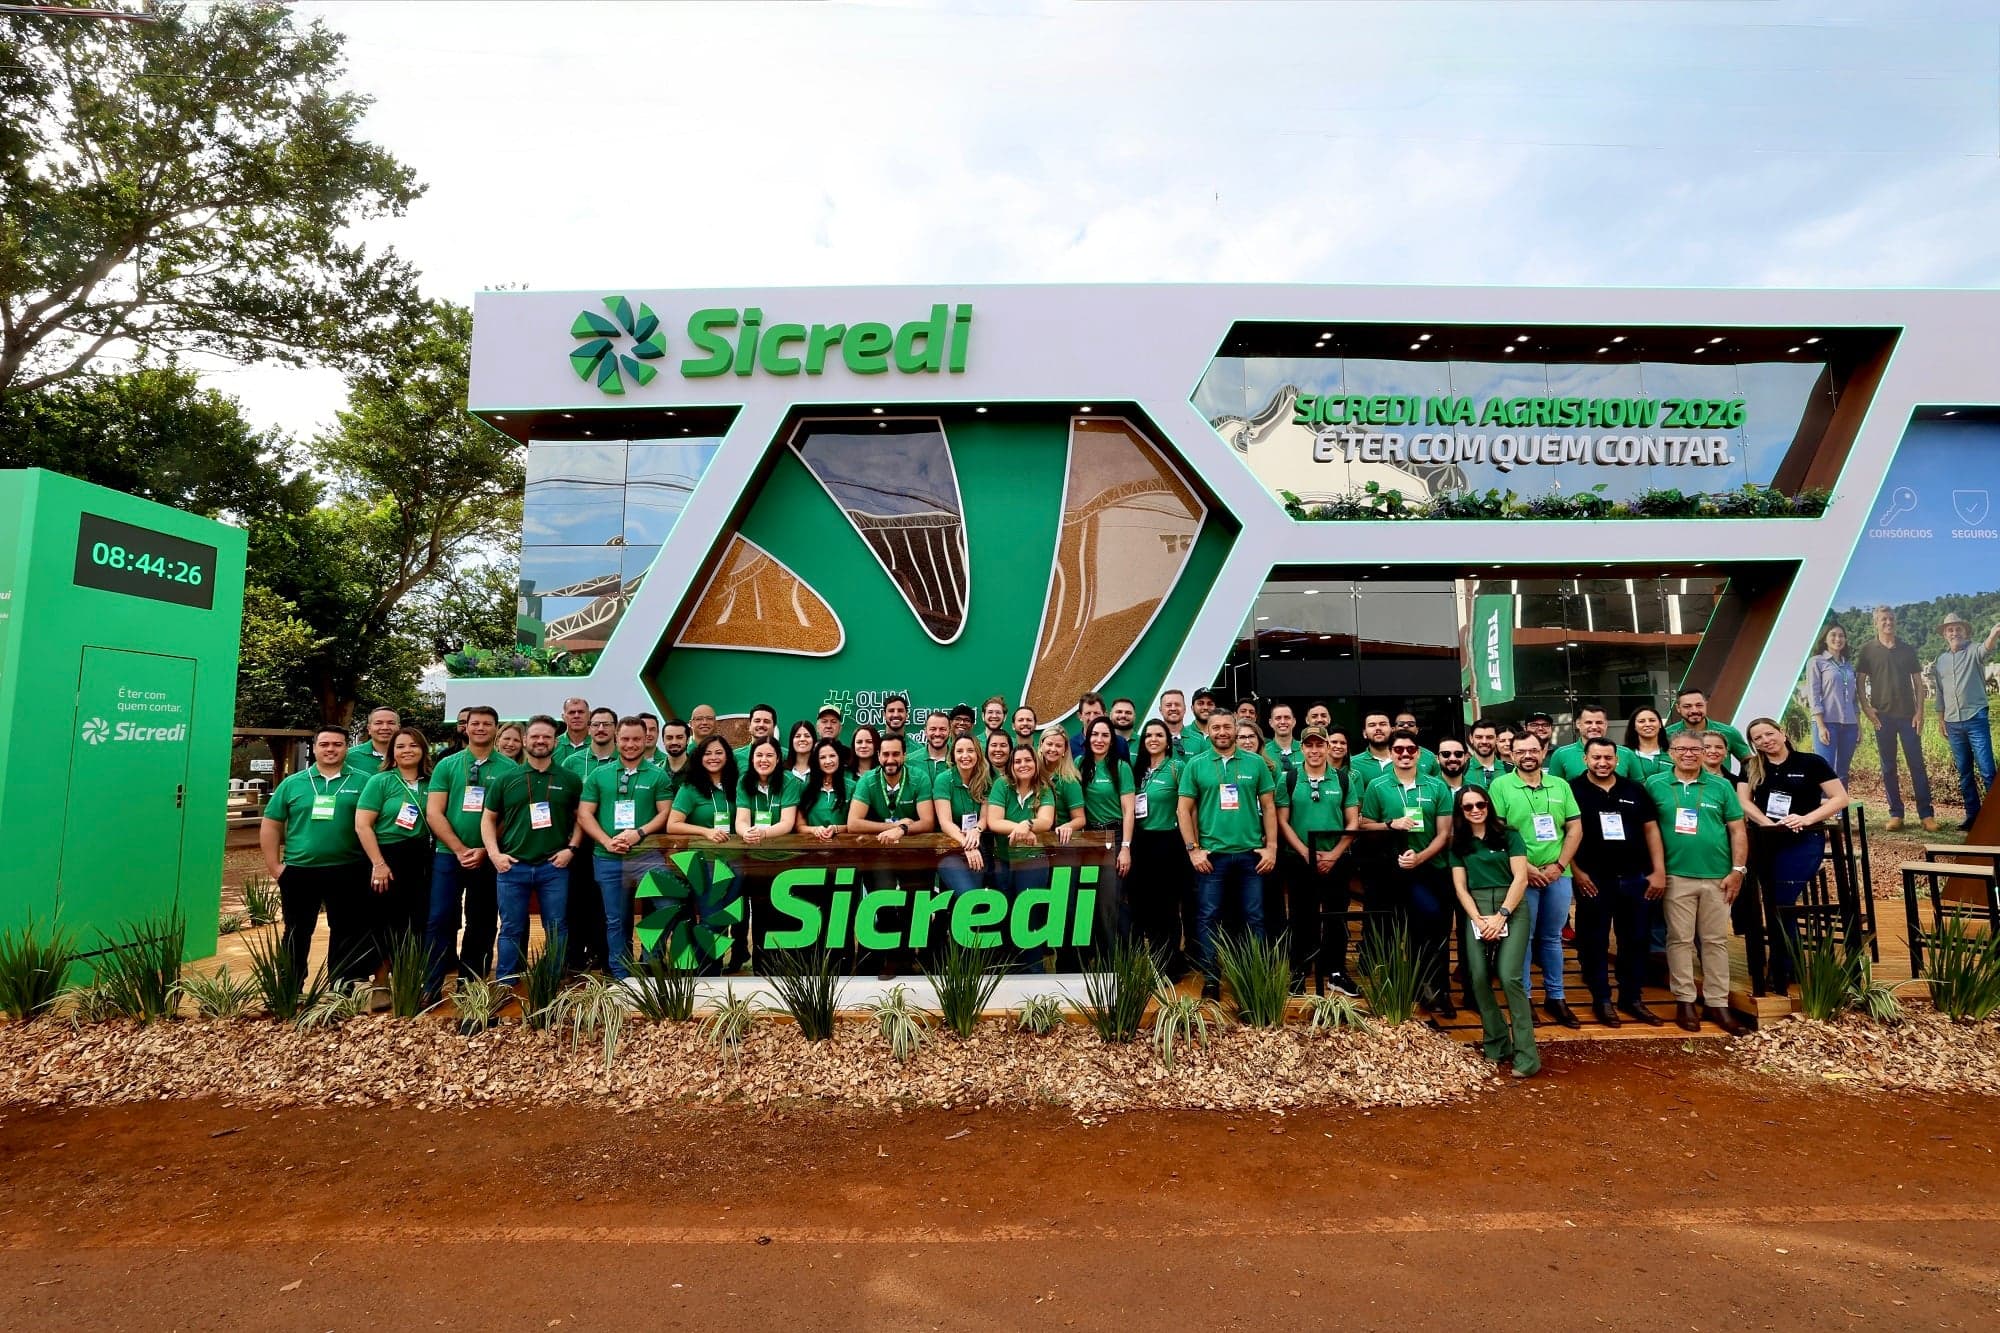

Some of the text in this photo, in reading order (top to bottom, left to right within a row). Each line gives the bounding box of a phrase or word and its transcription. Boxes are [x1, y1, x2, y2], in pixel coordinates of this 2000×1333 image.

[680, 304, 973, 378] Sicredi
[1293, 394, 1748, 429] SICREDI NA AGRISHOW 2026
[1338, 433, 1405, 464] TER
[1408, 433, 1487, 465] COM
[1489, 434, 1592, 473] QUEM
[1593, 435, 1736, 466] CONTAR.
[1869, 528, 1933, 539] CONSÓRCIOS
[1951, 529, 1998, 539] SEGUROS
[92, 542, 203, 585] 08:44:26
[118, 685, 166, 701] É ter com
[117, 702, 182, 713] quem contar.
[114, 722, 186, 741] Sicredi
[763, 866, 1100, 951] Sicredi
